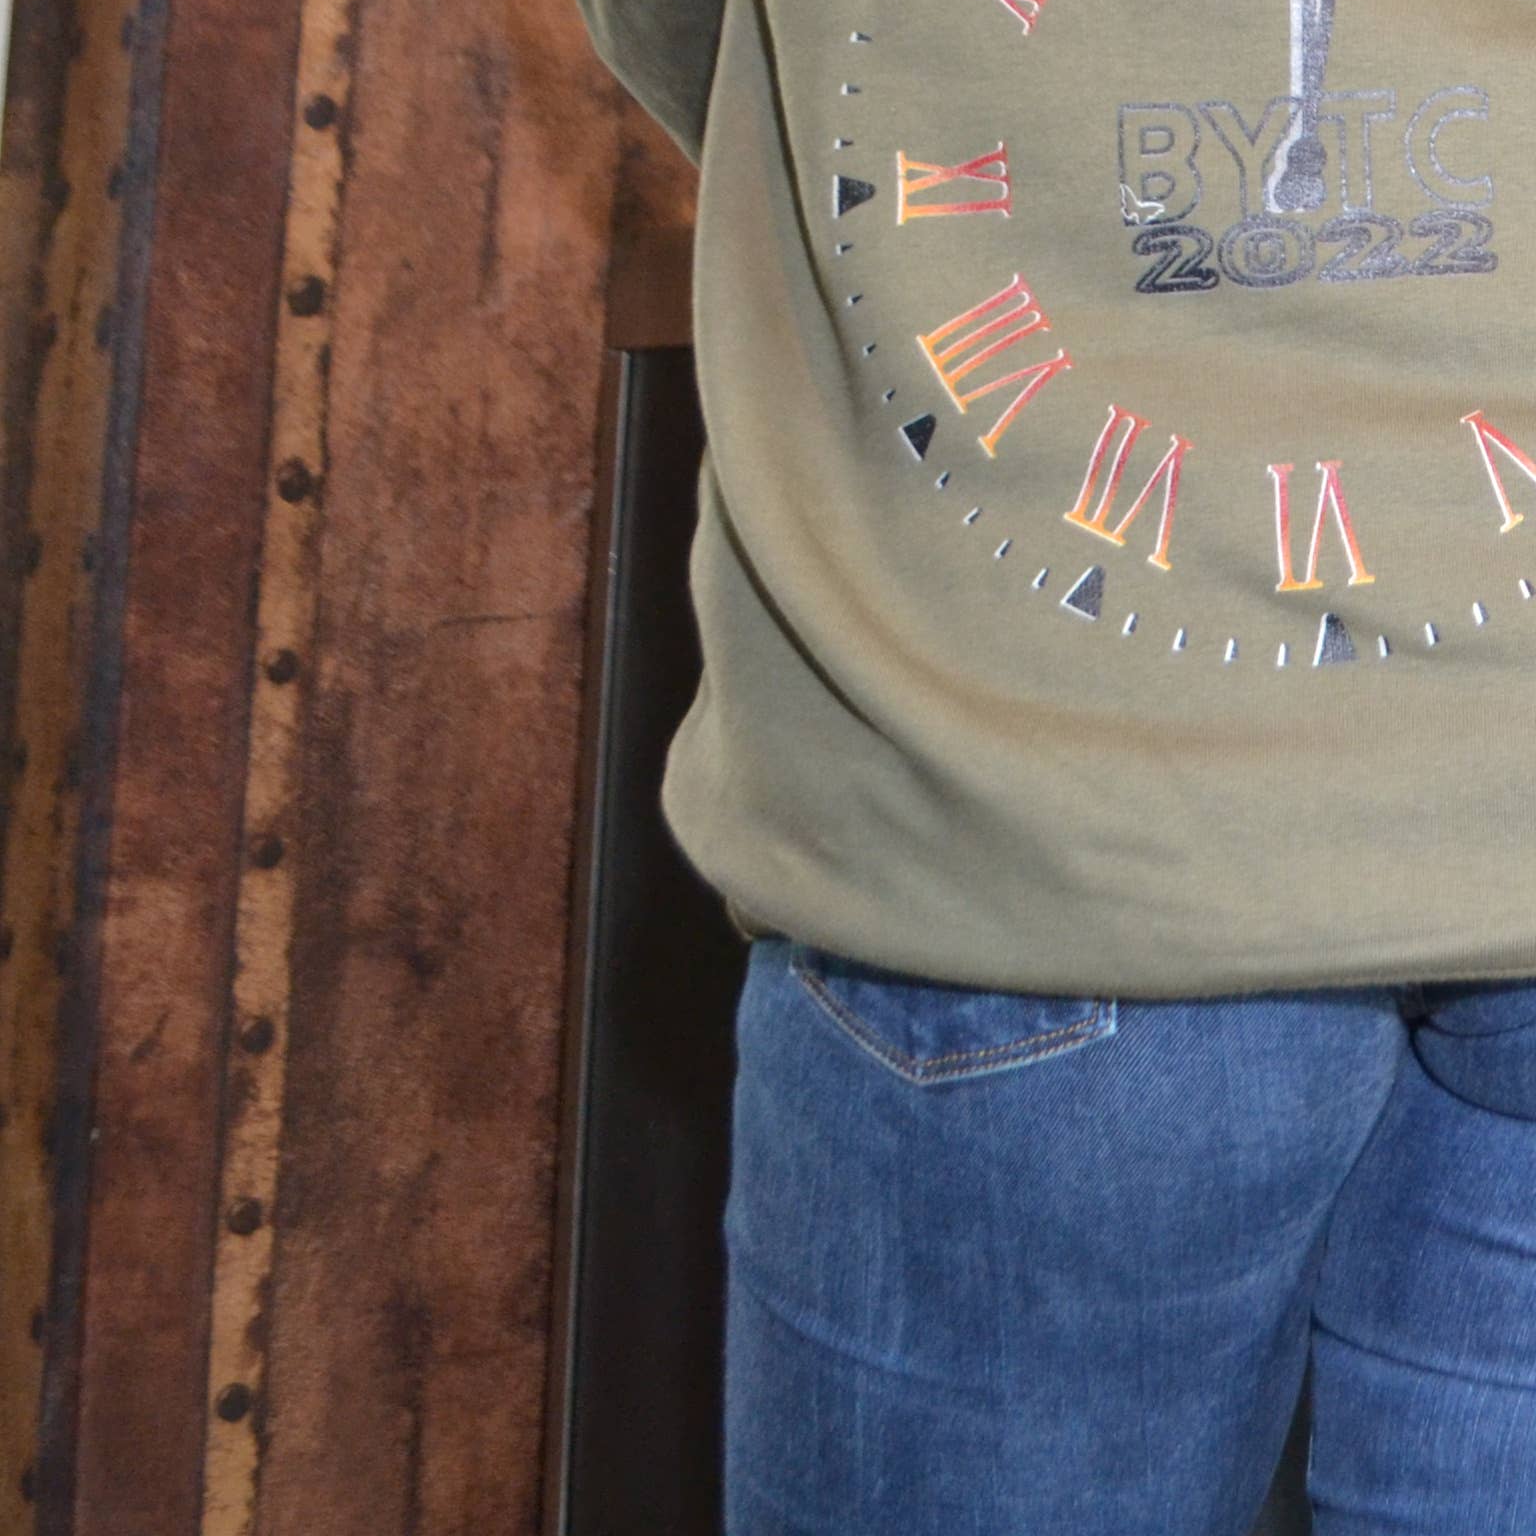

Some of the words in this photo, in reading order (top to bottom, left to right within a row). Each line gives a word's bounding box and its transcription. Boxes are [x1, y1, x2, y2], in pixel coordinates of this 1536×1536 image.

[896, 140, 1015, 227] IX
[1117, 83, 1496, 228] BYTC
[1131, 208, 1500, 295] 2022
[916, 271, 1076, 459] VIII
[1062, 403, 1196, 572] VII
[1267, 460, 1377, 594] VI
